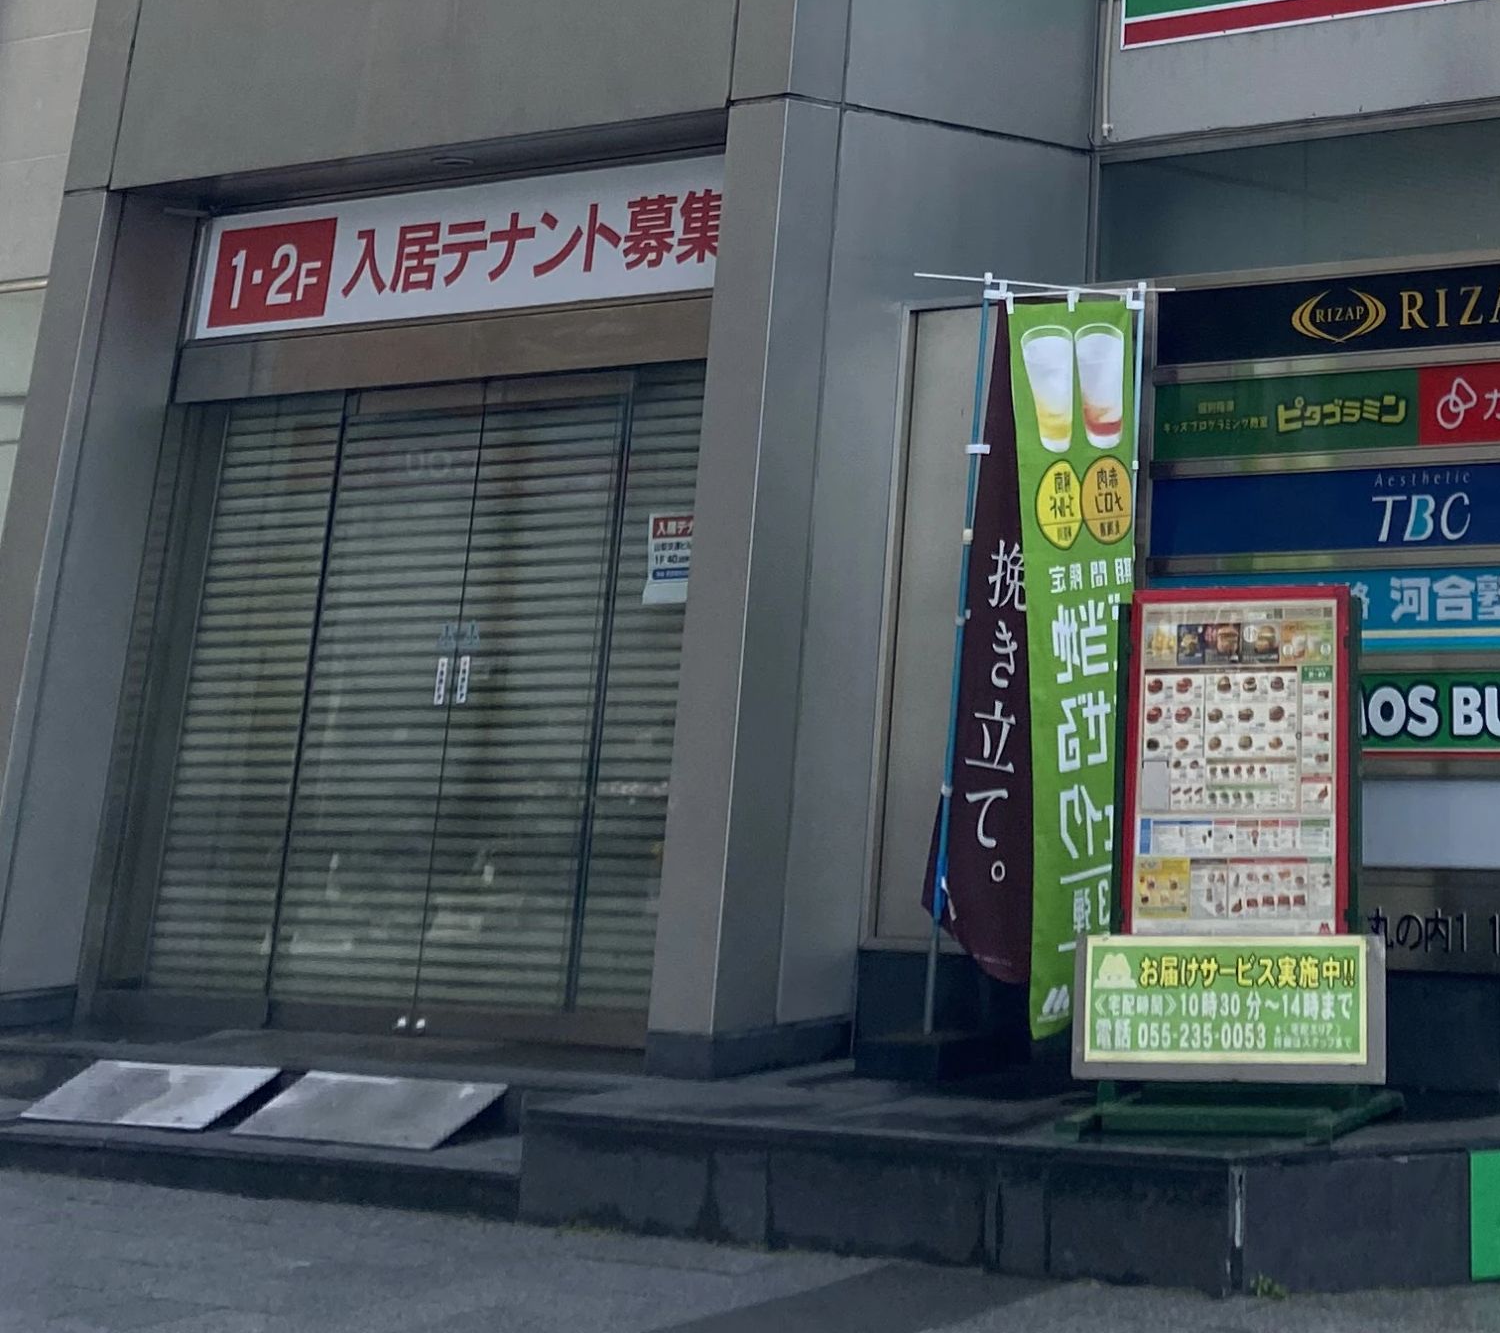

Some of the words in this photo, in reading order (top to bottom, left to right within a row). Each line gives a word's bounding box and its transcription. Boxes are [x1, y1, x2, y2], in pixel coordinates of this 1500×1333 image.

[341, 188, 724, 298] 入居テナント募集
[1315, 305, 1365, 323] RIZAP
[1277, 394, 1407, 433] ピタゴラミン
[1374, 469, 1472, 487] Aesthetic
[1371, 491, 1472, 542] TBC
[1361, 683, 1440, 737] OS
